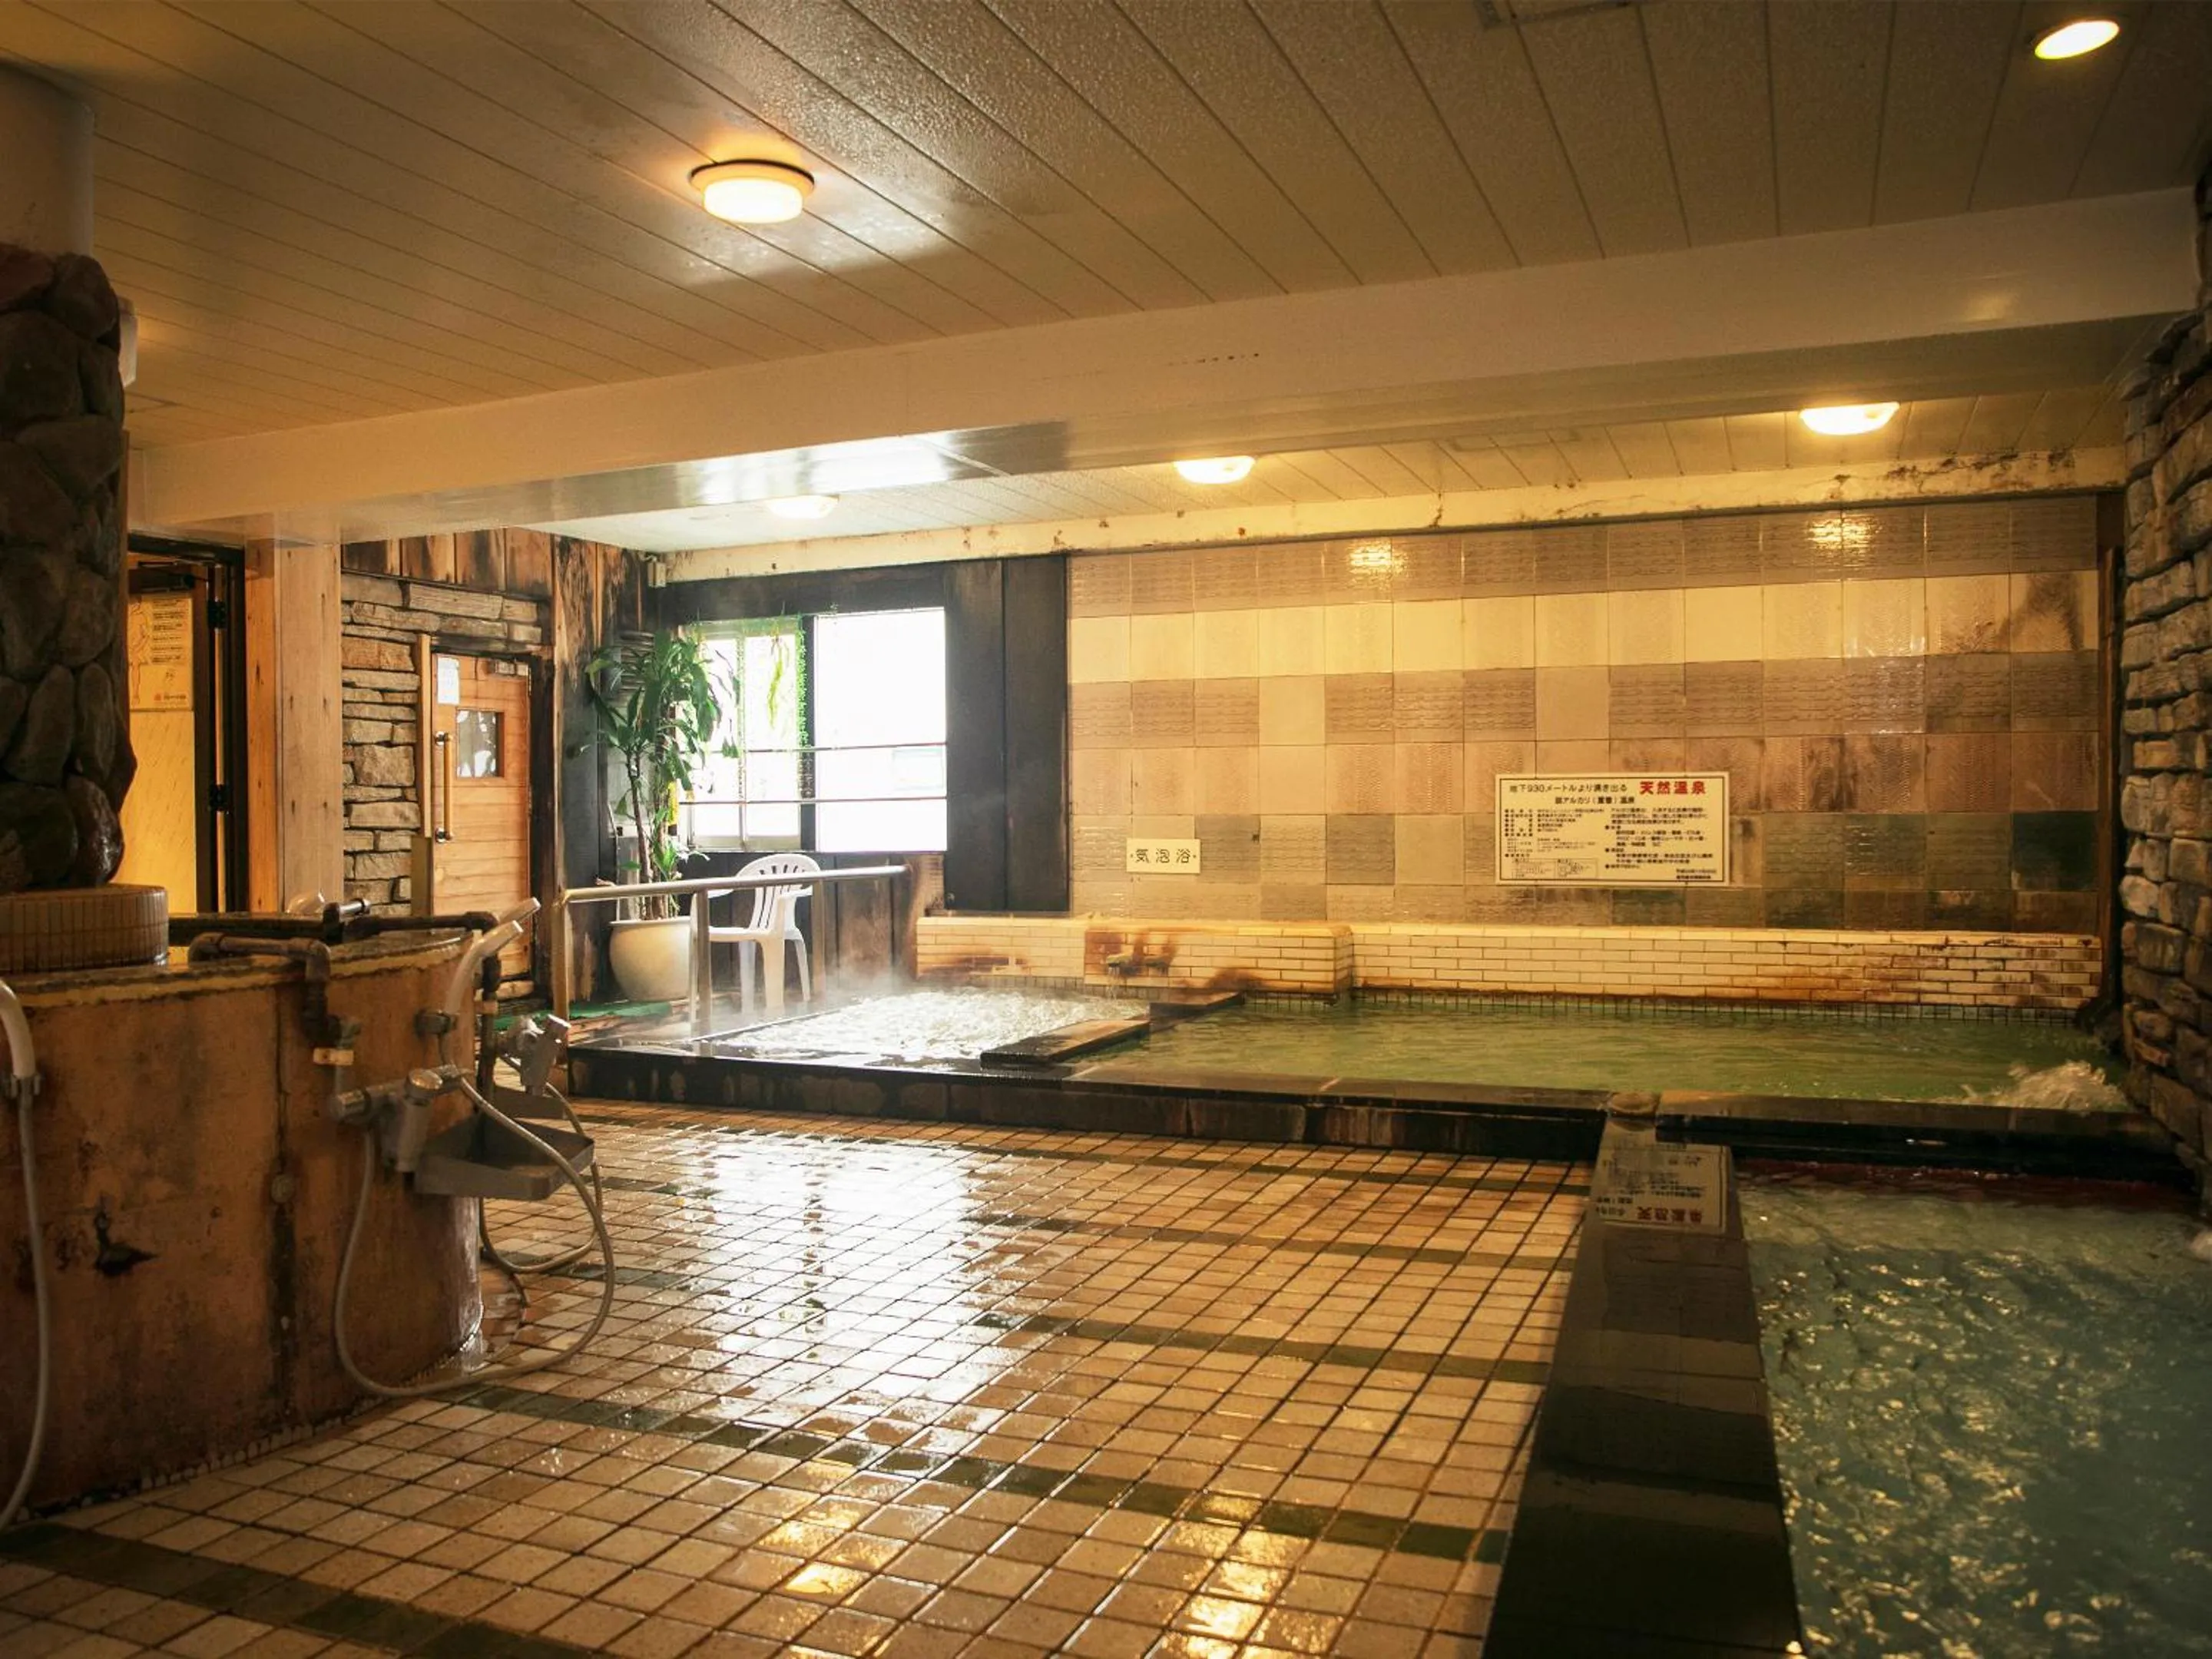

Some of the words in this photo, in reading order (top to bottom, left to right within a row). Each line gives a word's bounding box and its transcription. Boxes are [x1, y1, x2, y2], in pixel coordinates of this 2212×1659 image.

[1639, 780, 1707, 795] 天然温泉
[1135, 848, 1190, 863] 気泡浴
